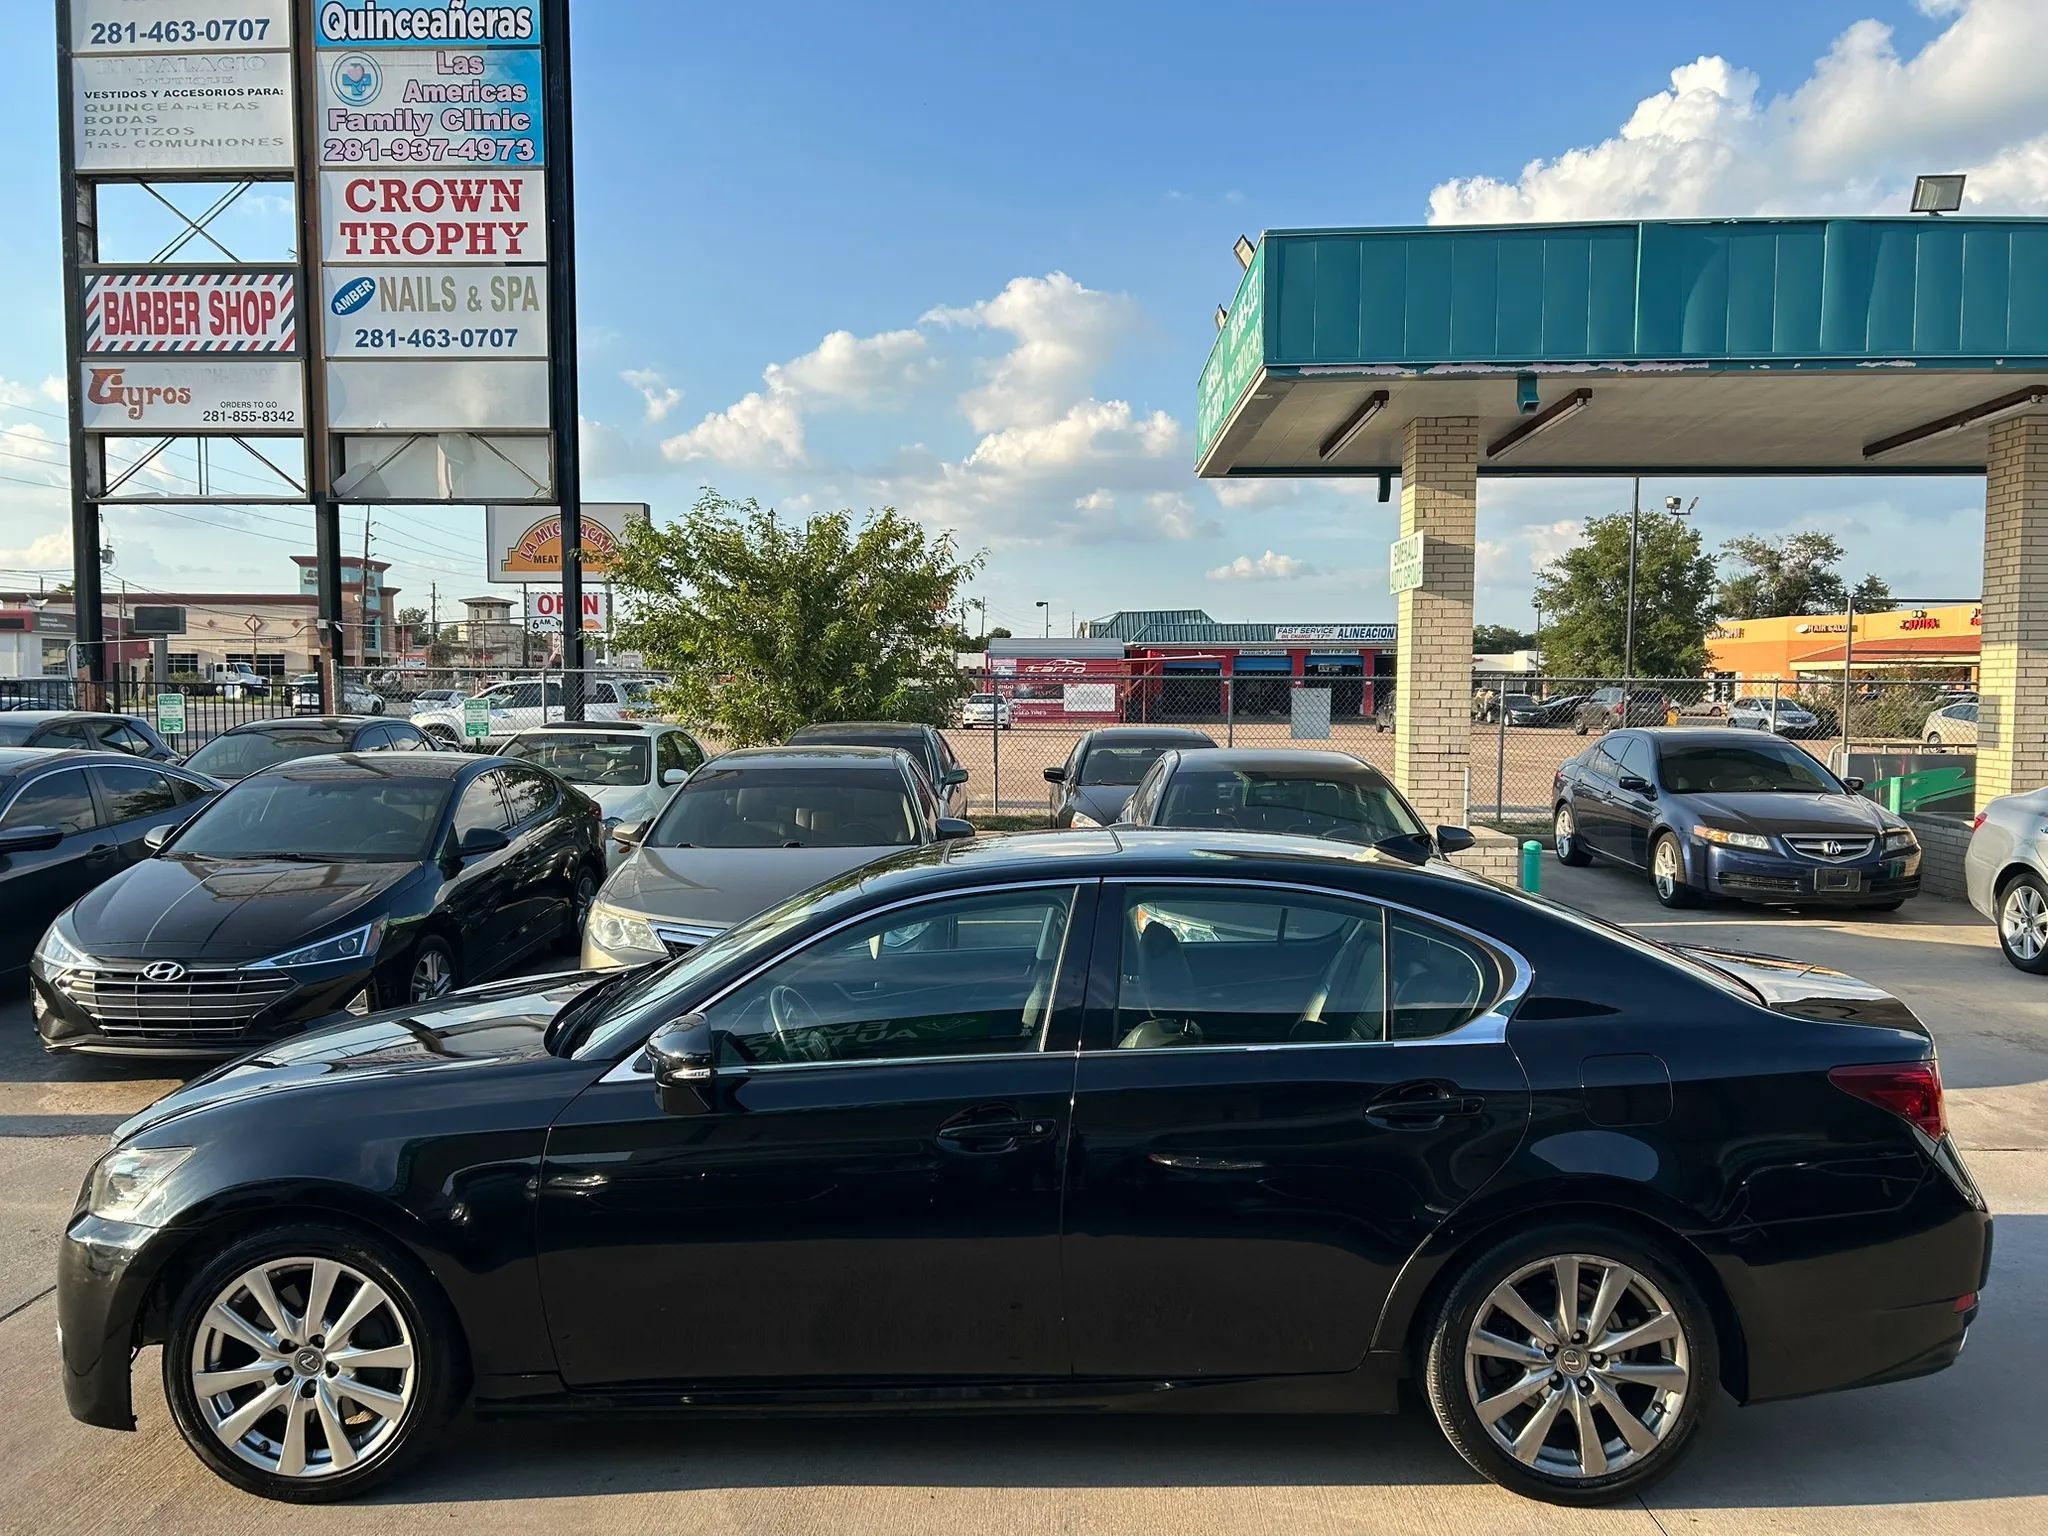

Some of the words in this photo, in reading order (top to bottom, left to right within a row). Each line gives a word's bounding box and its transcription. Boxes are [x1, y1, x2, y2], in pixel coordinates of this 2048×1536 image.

[90, 18, 271, 44] 281-463-0707
[321, 0, 532, 42] Quinceañeras
[436, 51, 485, 75] Las
[84, 90, 147, 99] VESTIDOS
[152, 90, 160, 98] Y
[163, 88, 245, 98] ACCESORIOS
[248, 87, 285, 96] PARA:
[403, 80, 528, 103] Americas
[84, 115, 158, 125] BODAS
[328, 108, 433, 136] Family
[440, 108, 531, 132] Clinic
[84, 127, 195, 137] BAUTIZOS
[134, 137, 285, 148] COMUNIONES
[324, 138, 536, 161] 281-937-4973
[345, 179, 523, 213] CROWN
[340, 222, 528, 255] TROPHY
[334, 279, 374, 314] AMBER
[379, 276, 457, 312] NAILS
[467, 285, 482, 312] &
[490, 275, 539, 312] SPA
[103, 291, 201, 336] BARBER
[208, 290, 276, 336] SHOP
[355, 328, 518, 348] 281-463-0707
[88, 368, 192, 420] Gyros
[220, 401, 252, 409] ORDERS
[202, 410, 295, 422] 281-855-8342
[520, 541, 538, 561] LA
[533, 554, 559, 564] MEAT
[1337, 627, 1395, 639] ALINEACION
